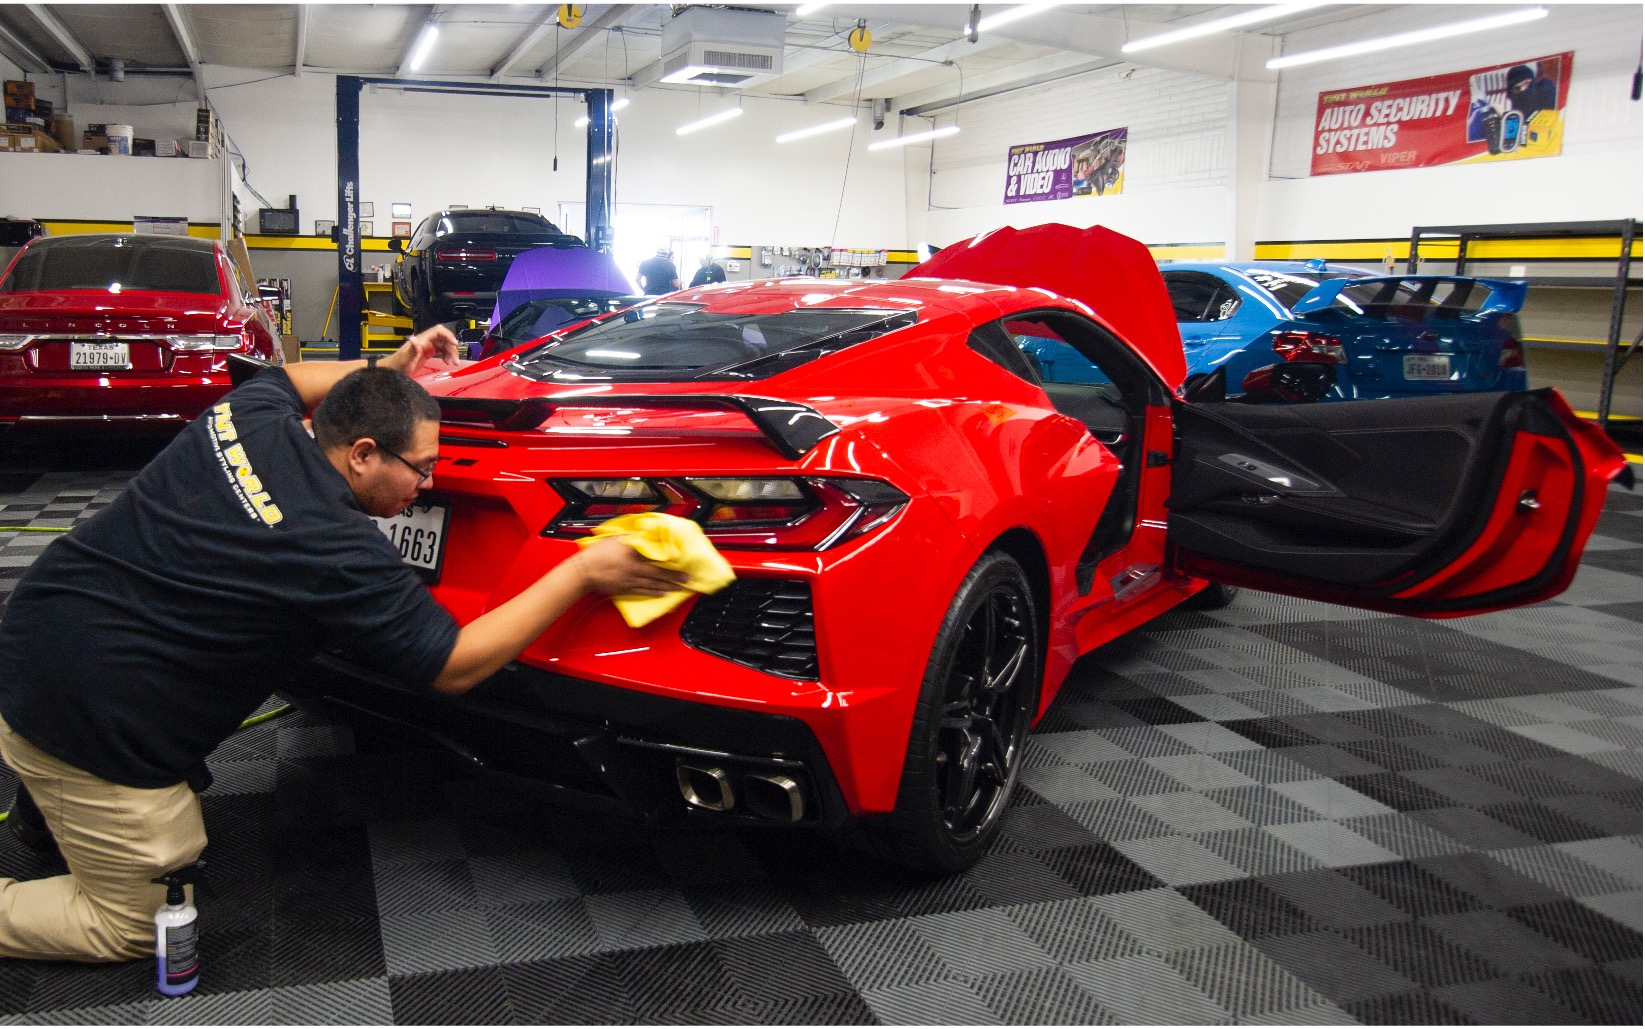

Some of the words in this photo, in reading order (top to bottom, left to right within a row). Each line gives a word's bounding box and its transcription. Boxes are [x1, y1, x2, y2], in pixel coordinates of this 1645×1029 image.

[1317, 103, 1365, 131] AUTO
[1365, 89, 1462, 125] SECURITY
[1315, 124, 1399, 155] SYSTEMS
[1009, 152, 1034, 176] CAR
[1033, 147, 1072, 173] AUDIO
[1380, 150, 1418, 163] VIPER
[344, 181, 354, 202] Lifts
[1006, 175, 1018, 197] &
[1020, 171, 1054, 196] VIDEO
[342, 202, 356, 255] Challenger
[215, 451, 236, 484] STYLING
[232, 483, 258, 520] CENTERS
[224, 442, 284, 525] WORLD
